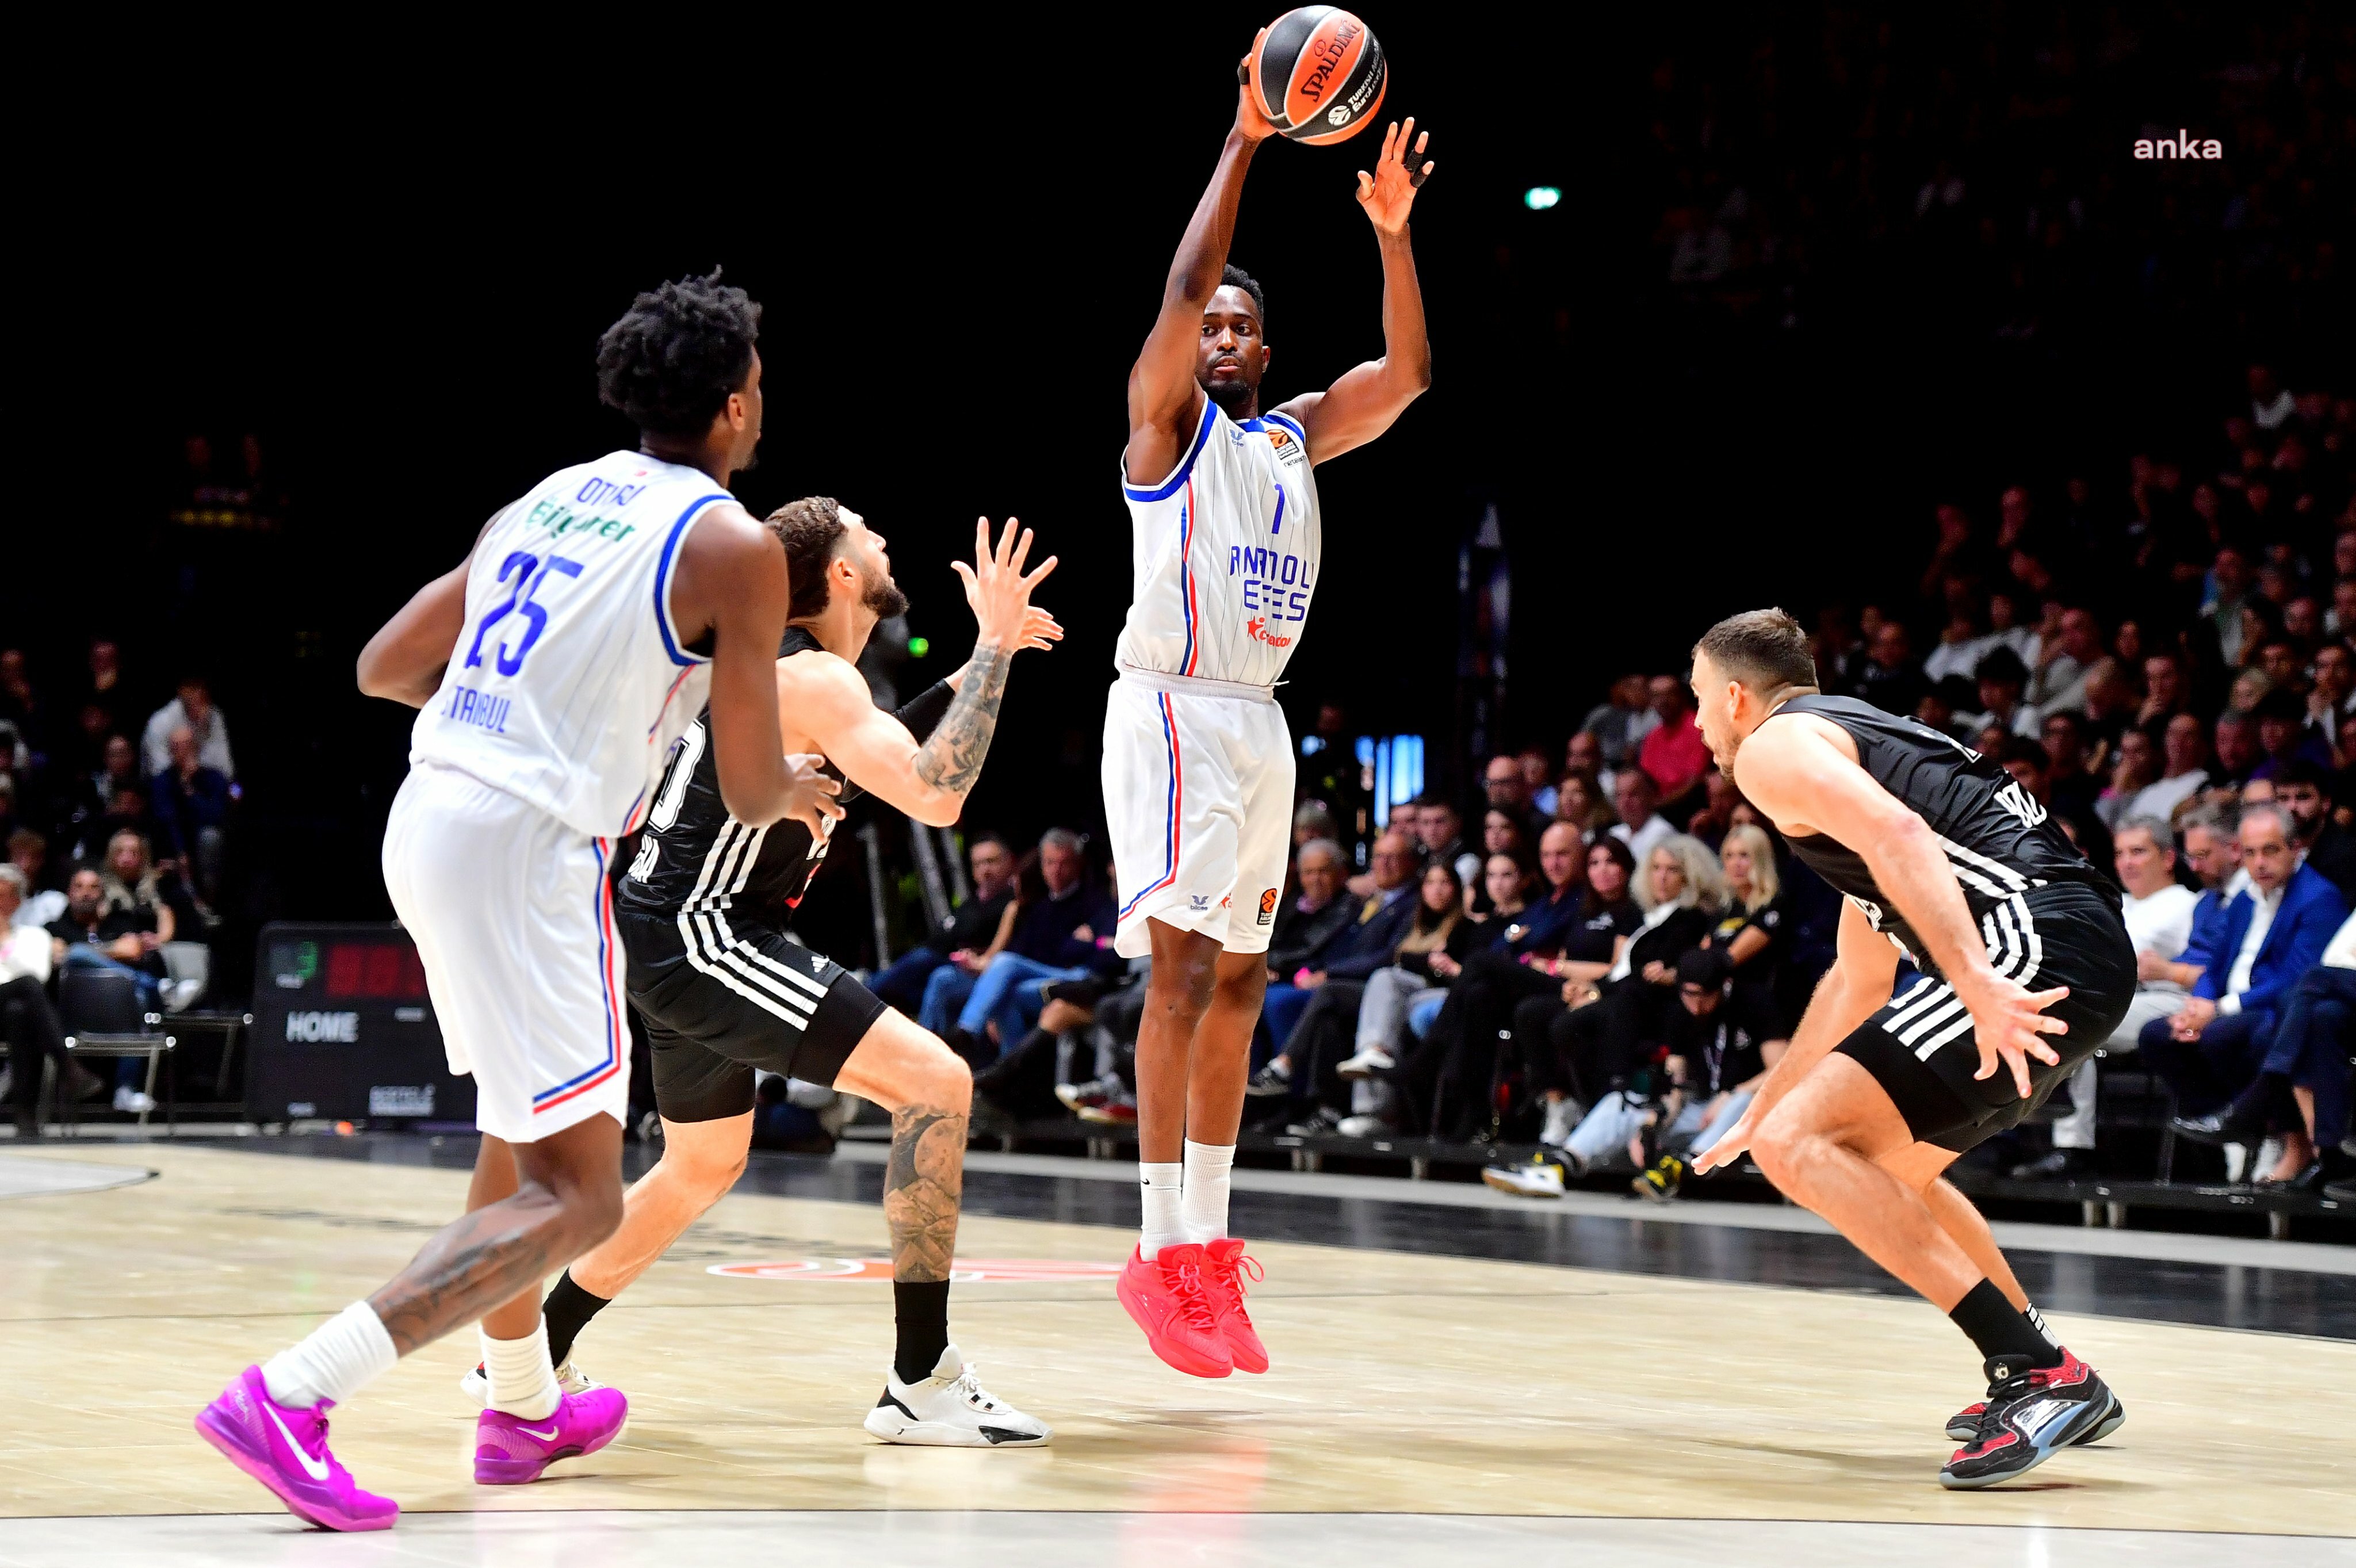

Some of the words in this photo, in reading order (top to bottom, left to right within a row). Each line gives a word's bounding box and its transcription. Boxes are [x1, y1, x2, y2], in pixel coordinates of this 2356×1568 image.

[1301, 19, 1361, 102] SPALDING
[1271, 483, 1286, 534] 1
[464, 550, 584, 677] 25
[1244, 579, 1307, 621] EFES
[285, 1011, 359, 1043] HOME
